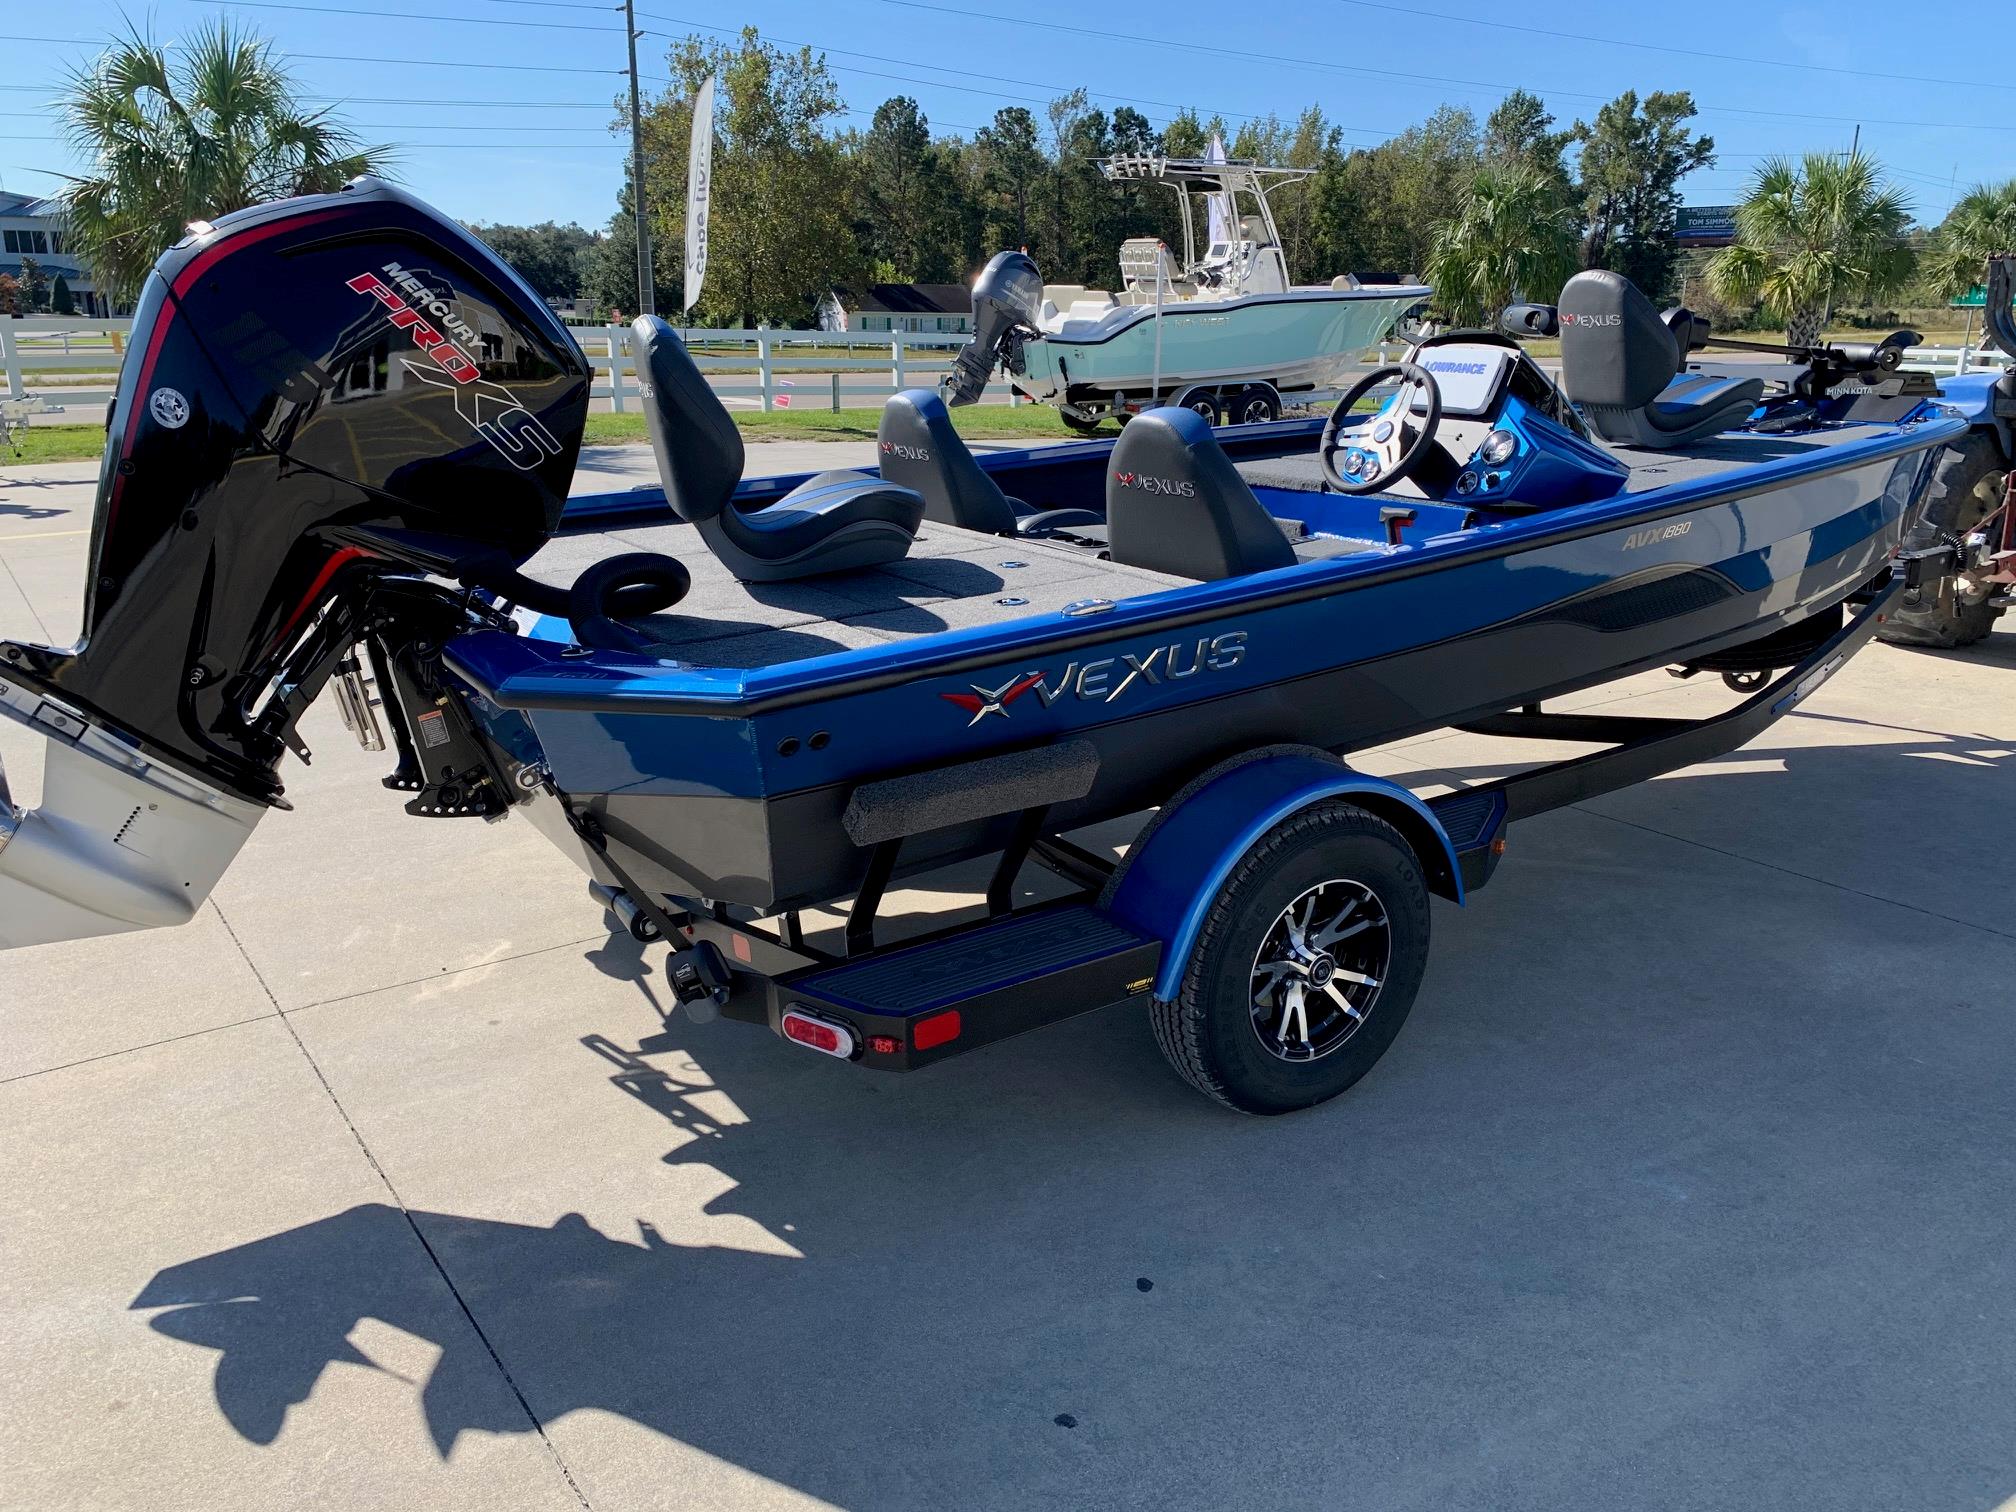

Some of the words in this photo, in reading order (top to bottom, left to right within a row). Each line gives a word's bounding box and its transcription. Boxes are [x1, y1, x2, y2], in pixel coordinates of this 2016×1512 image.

[1688, 218, 1704, 226] TOM
[381, 261, 488, 348] MERCURY
[345, 271, 482, 385] PRO
[1574, 313, 1623, 328] VEXUS
[1424, 361, 1487, 375] LOWRANCE
[1826, 387, 1850, 396] MINN
[1850, 386, 1873, 395] KOTA
[399, 338, 563, 471] XS
[894, 442, 930, 462] VEXUS
[1135, 473, 1196, 499] VEXUS
[1026, 630, 1249, 708] VEXUS
